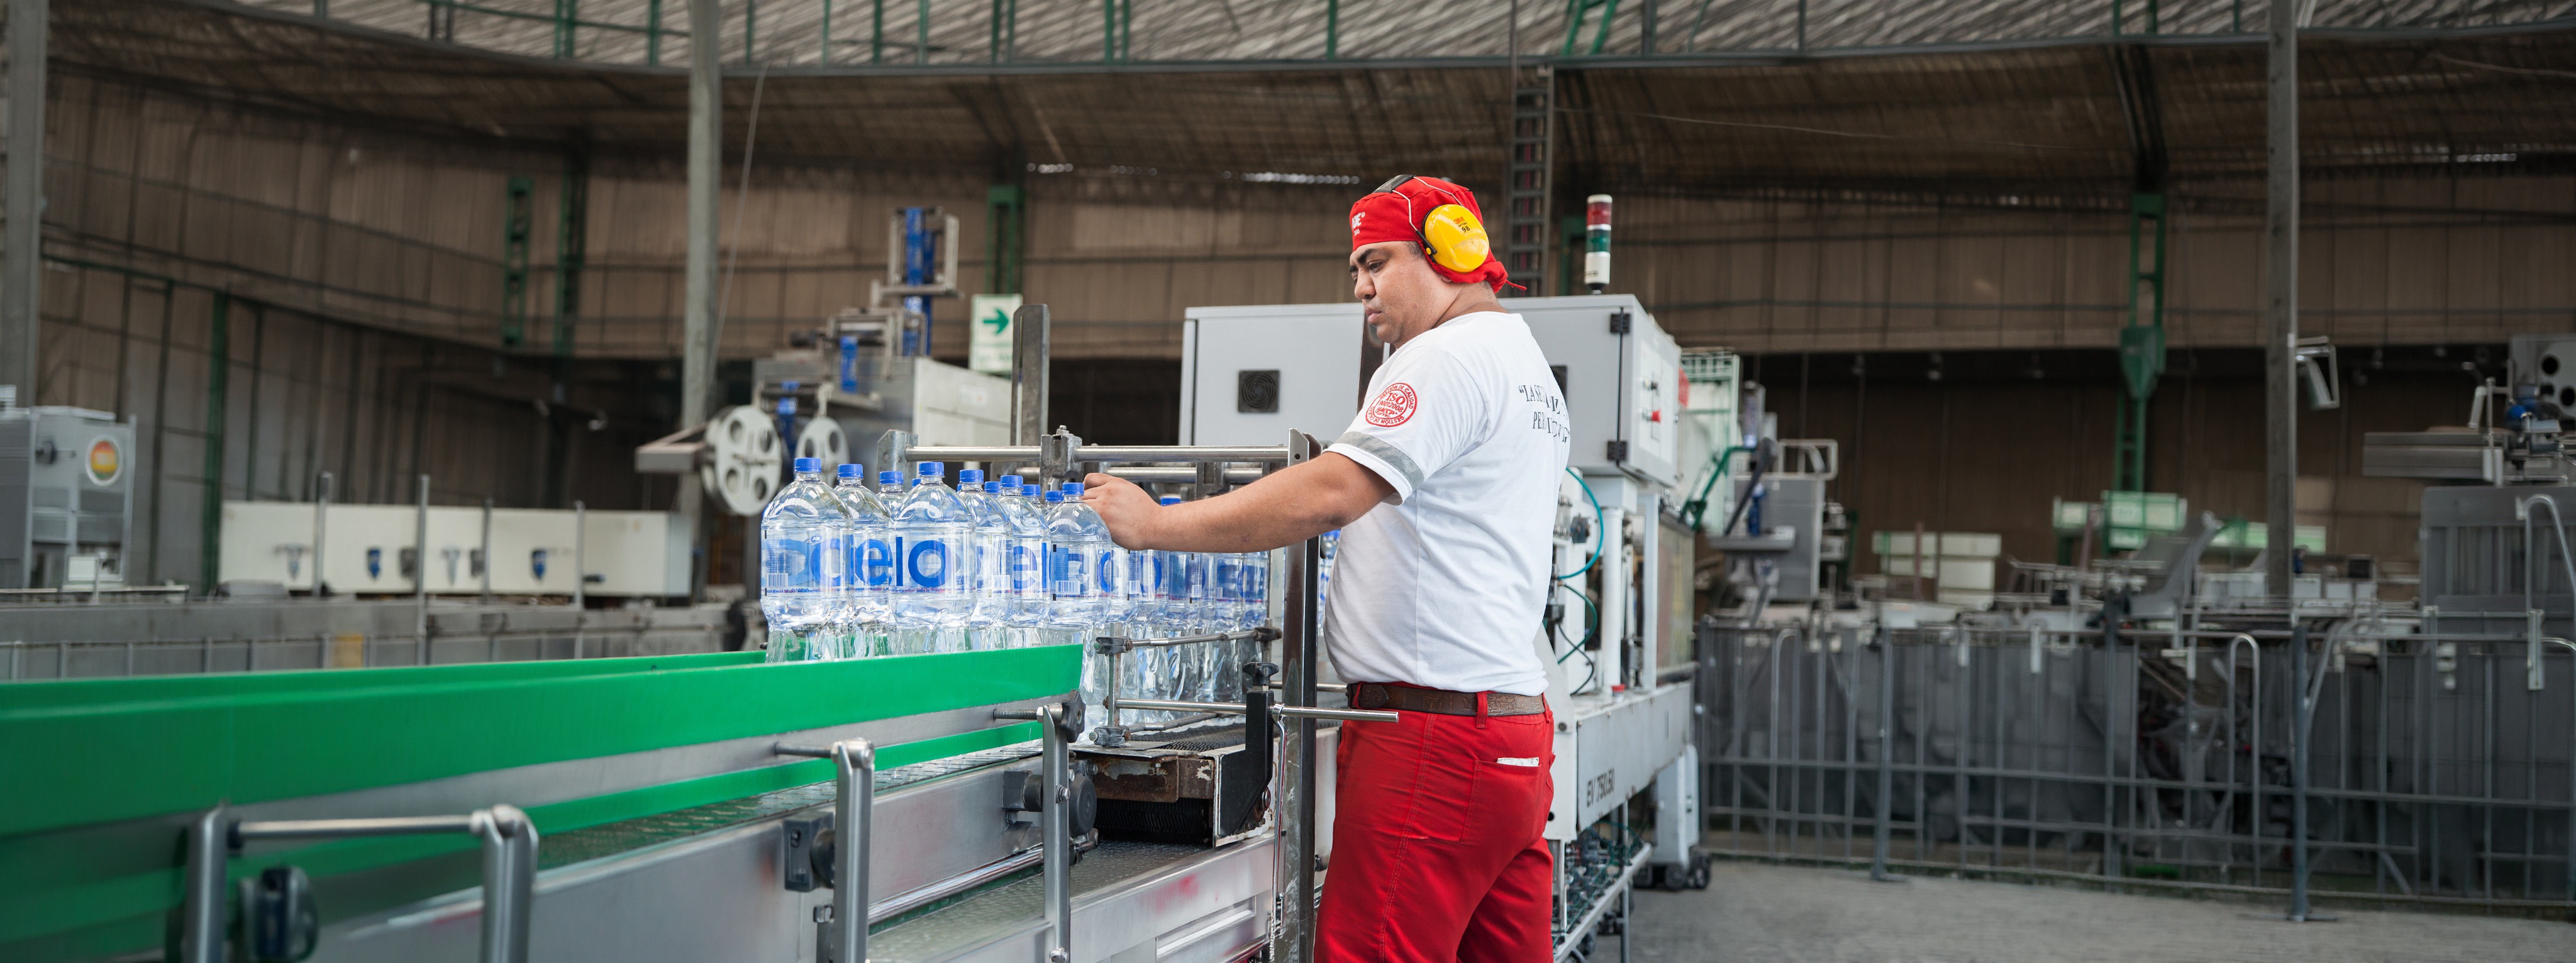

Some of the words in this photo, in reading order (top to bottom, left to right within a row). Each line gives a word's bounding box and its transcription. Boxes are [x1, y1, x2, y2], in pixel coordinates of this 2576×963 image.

[1453, 216, 1465, 224] 3M
[1462, 225, 1470, 233] 98
[1385, 392, 1406, 405] ISO
[1404, 388, 1414, 409] CALIDAD
